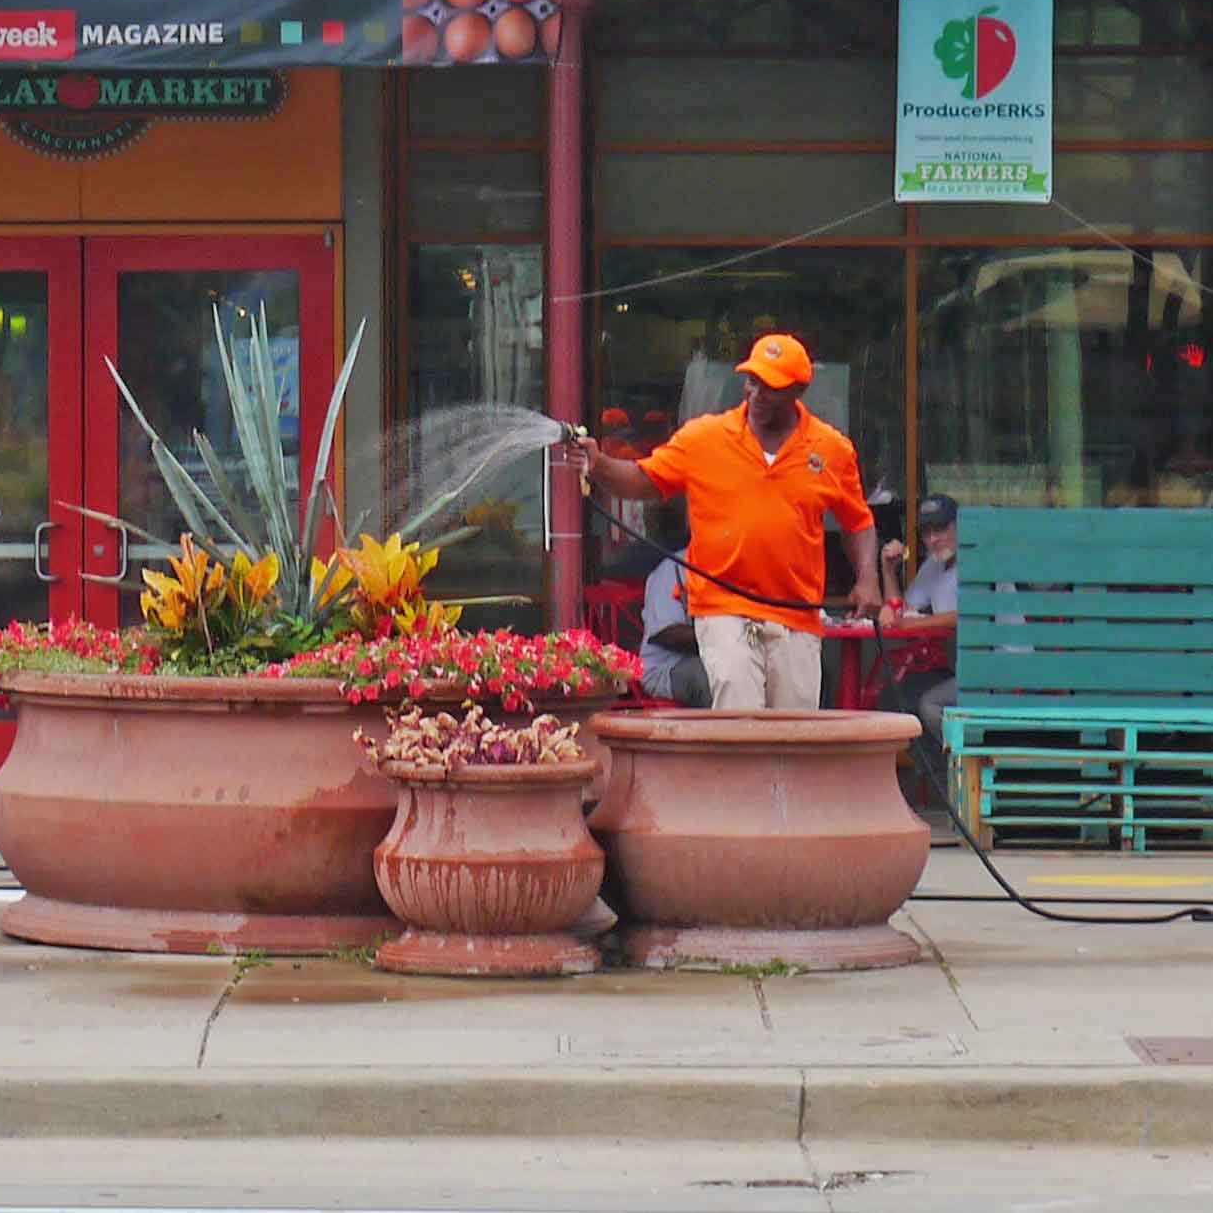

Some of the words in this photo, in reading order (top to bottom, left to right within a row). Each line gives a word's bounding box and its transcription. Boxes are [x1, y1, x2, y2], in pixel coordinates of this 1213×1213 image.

[82, 23, 225, 46] MAGAZINE
[97, 76, 272, 105] MARKET
[903, 102, 1046, 118] ProducePERKS
[944, 151, 1004, 162] NATIONAL
[919, 164, 1029, 181] FARMERS
